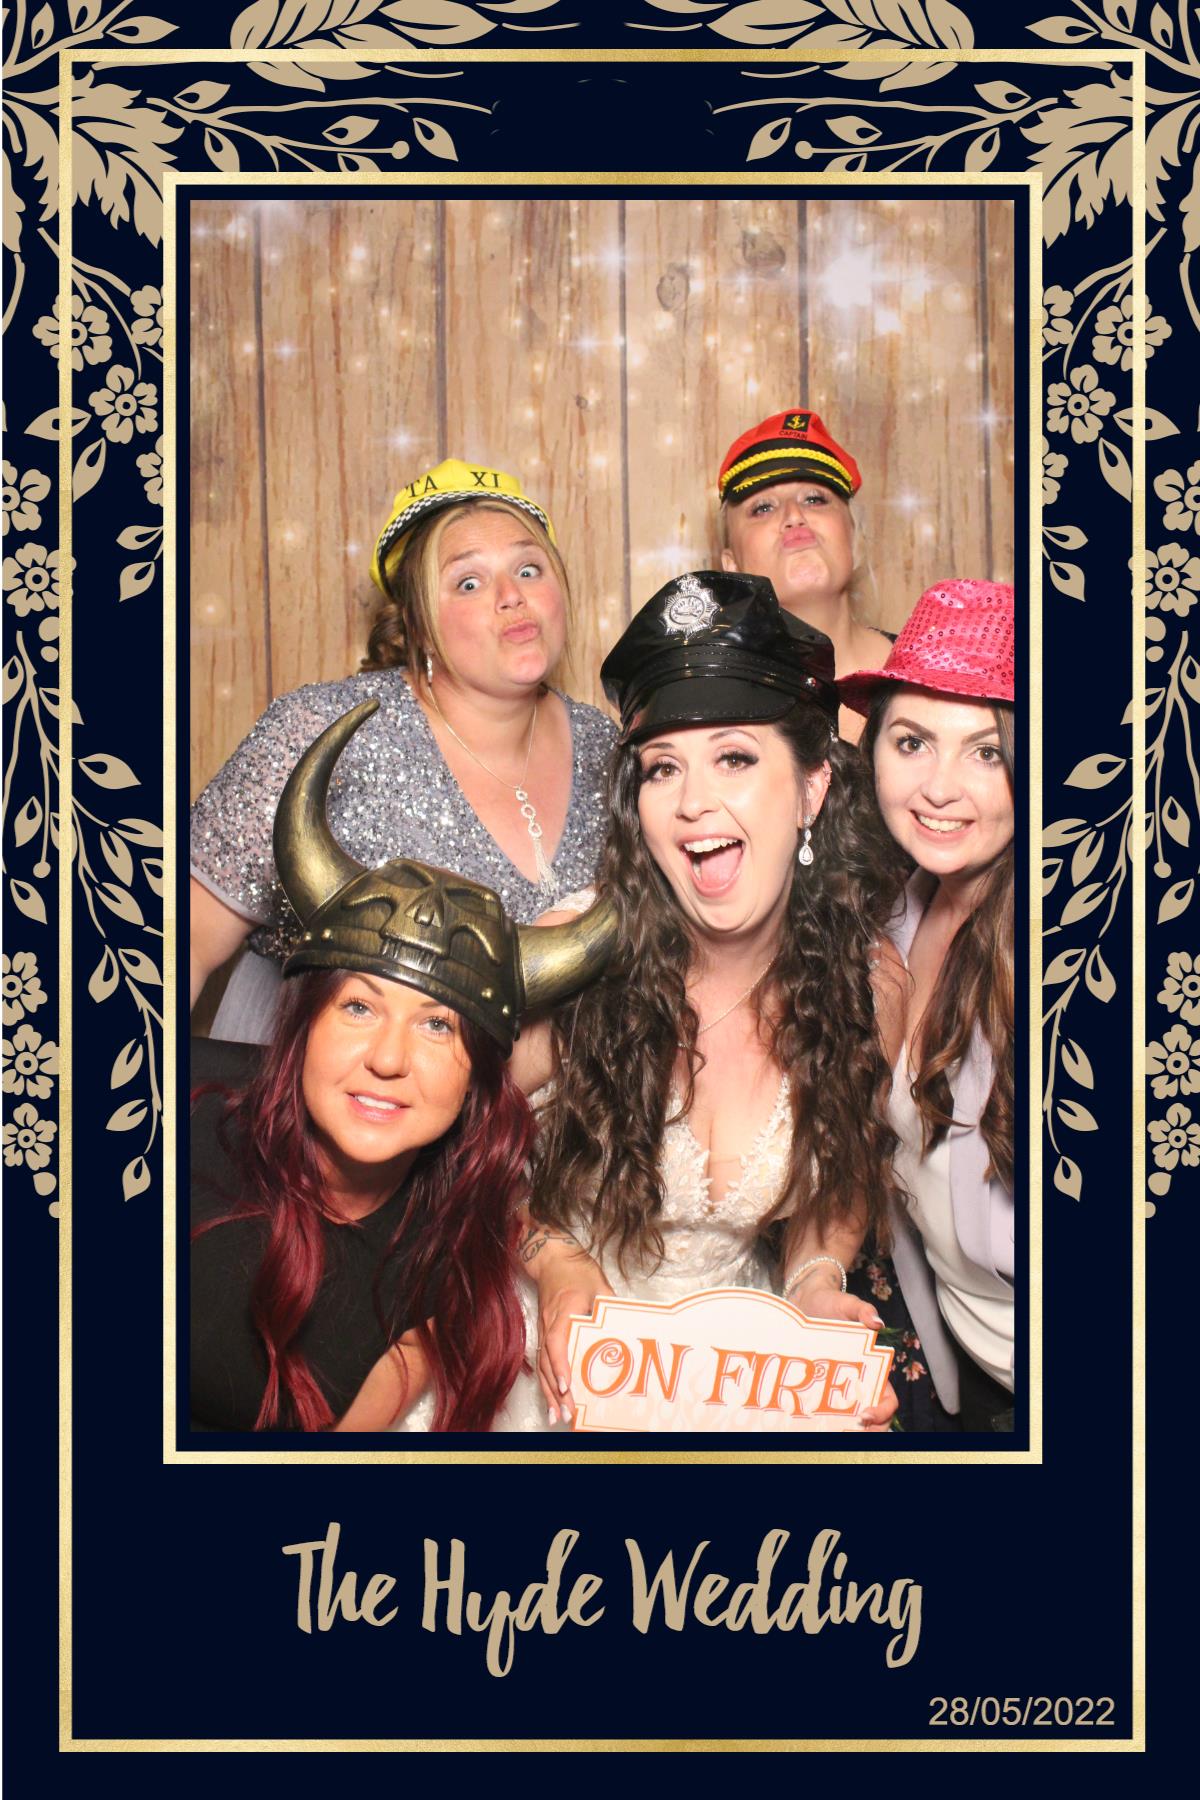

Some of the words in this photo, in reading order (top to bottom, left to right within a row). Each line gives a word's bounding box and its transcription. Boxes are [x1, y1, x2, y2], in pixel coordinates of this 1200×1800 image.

[779, 430, 808, 440] CAPTAIN
[580, 1337, 695, 1402] ON
[703, 1346, 866, 1419] FIRE
